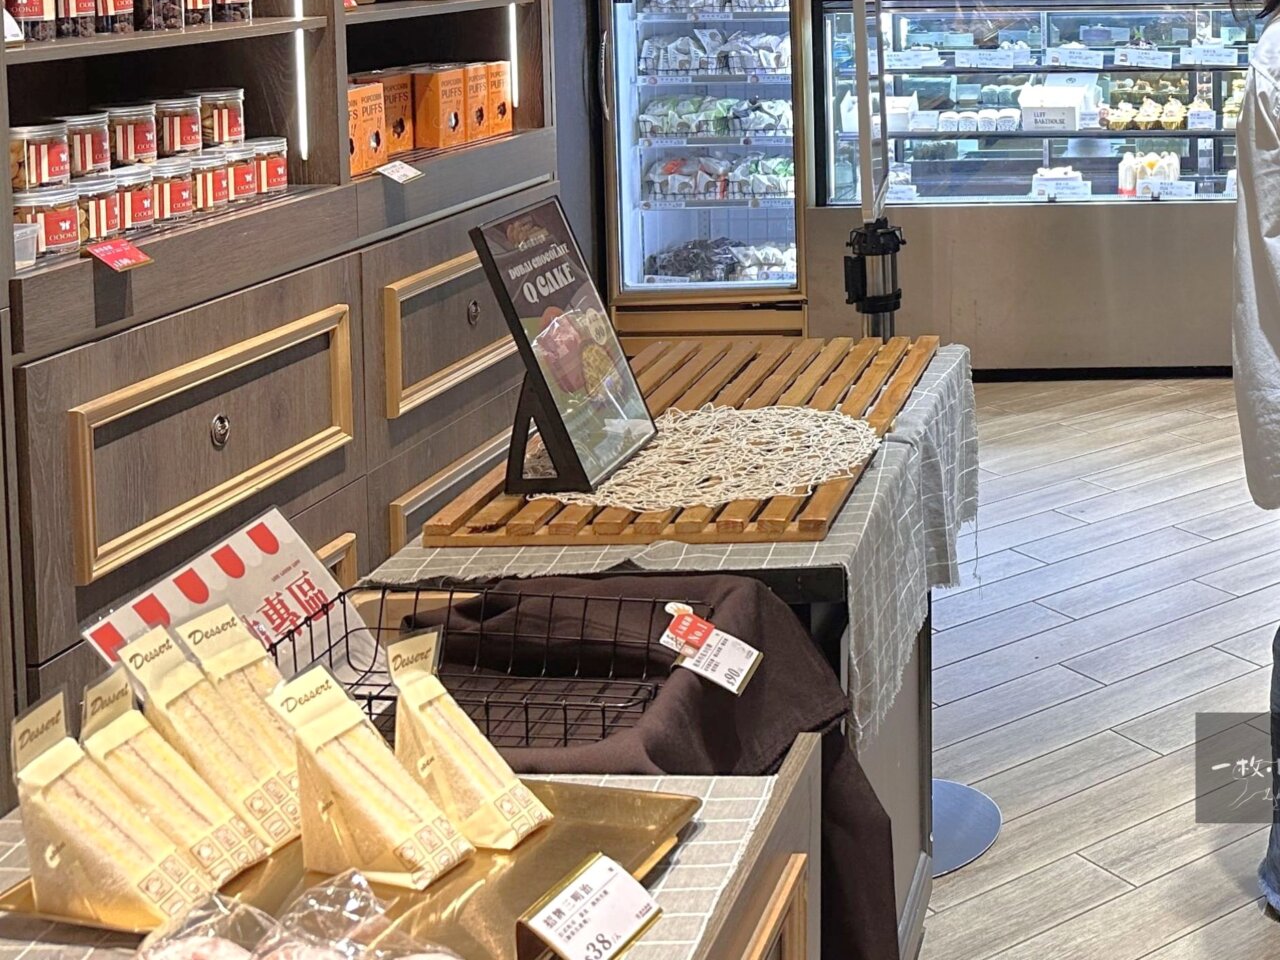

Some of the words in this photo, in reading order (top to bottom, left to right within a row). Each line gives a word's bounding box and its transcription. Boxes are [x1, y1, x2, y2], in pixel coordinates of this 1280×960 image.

[441, 86, 463, 99] PUFFS
[362, 102, 383, 118] PUFFS
[508, 260, 534, 280] DUBAI
[531, 243, 570, 269] CHOCOLATE
[522, 282, 540, 304] Q
[536, 262, 576, 297] CAKE
[188, 616, 238, 646] Dessert
[129, 637, 174, 670] Dessert
[392, 647, 432, 672] Dessert
[724, 667, 741, 686] $90
[90, 683, 128, 716] Dessert
[281, 679, 333, 713] Dessert
[19, 708, 62, 751] Dessert
[543, 883, 593, 929] 招牌三明治
